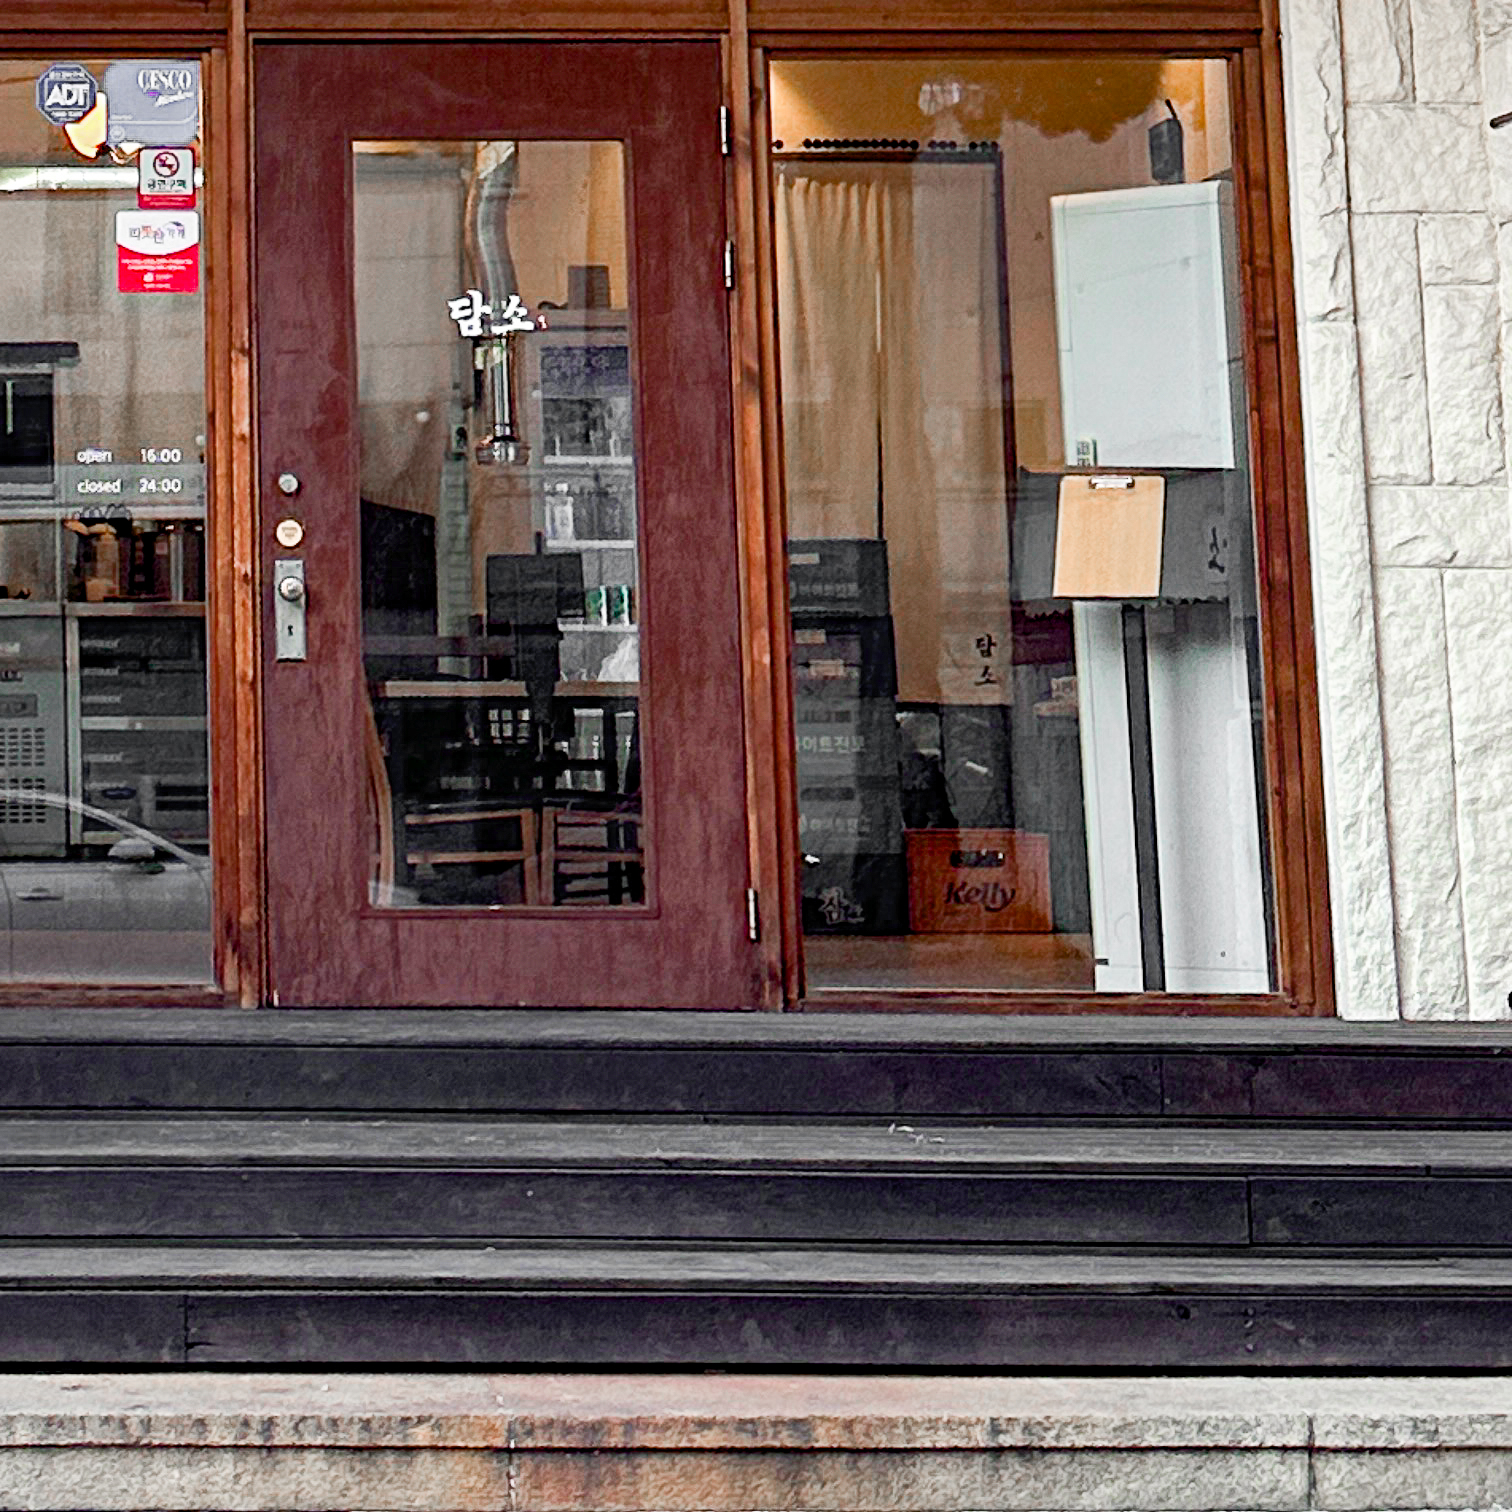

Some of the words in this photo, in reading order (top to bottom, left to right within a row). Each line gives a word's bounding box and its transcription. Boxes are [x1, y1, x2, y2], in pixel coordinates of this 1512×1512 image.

[137, 69, 193, 90] CESCO
[44, 82, 90, 106] ADT
[447, 289, 535, 336] 담소
[76, 448, 114, 465] open
[139, 448, 182, 463] 16:00
[76, 478, 122, 494] closed
[139, 478, 182, 493] 24:00
[946, 881, 1016, 912] Kelly
